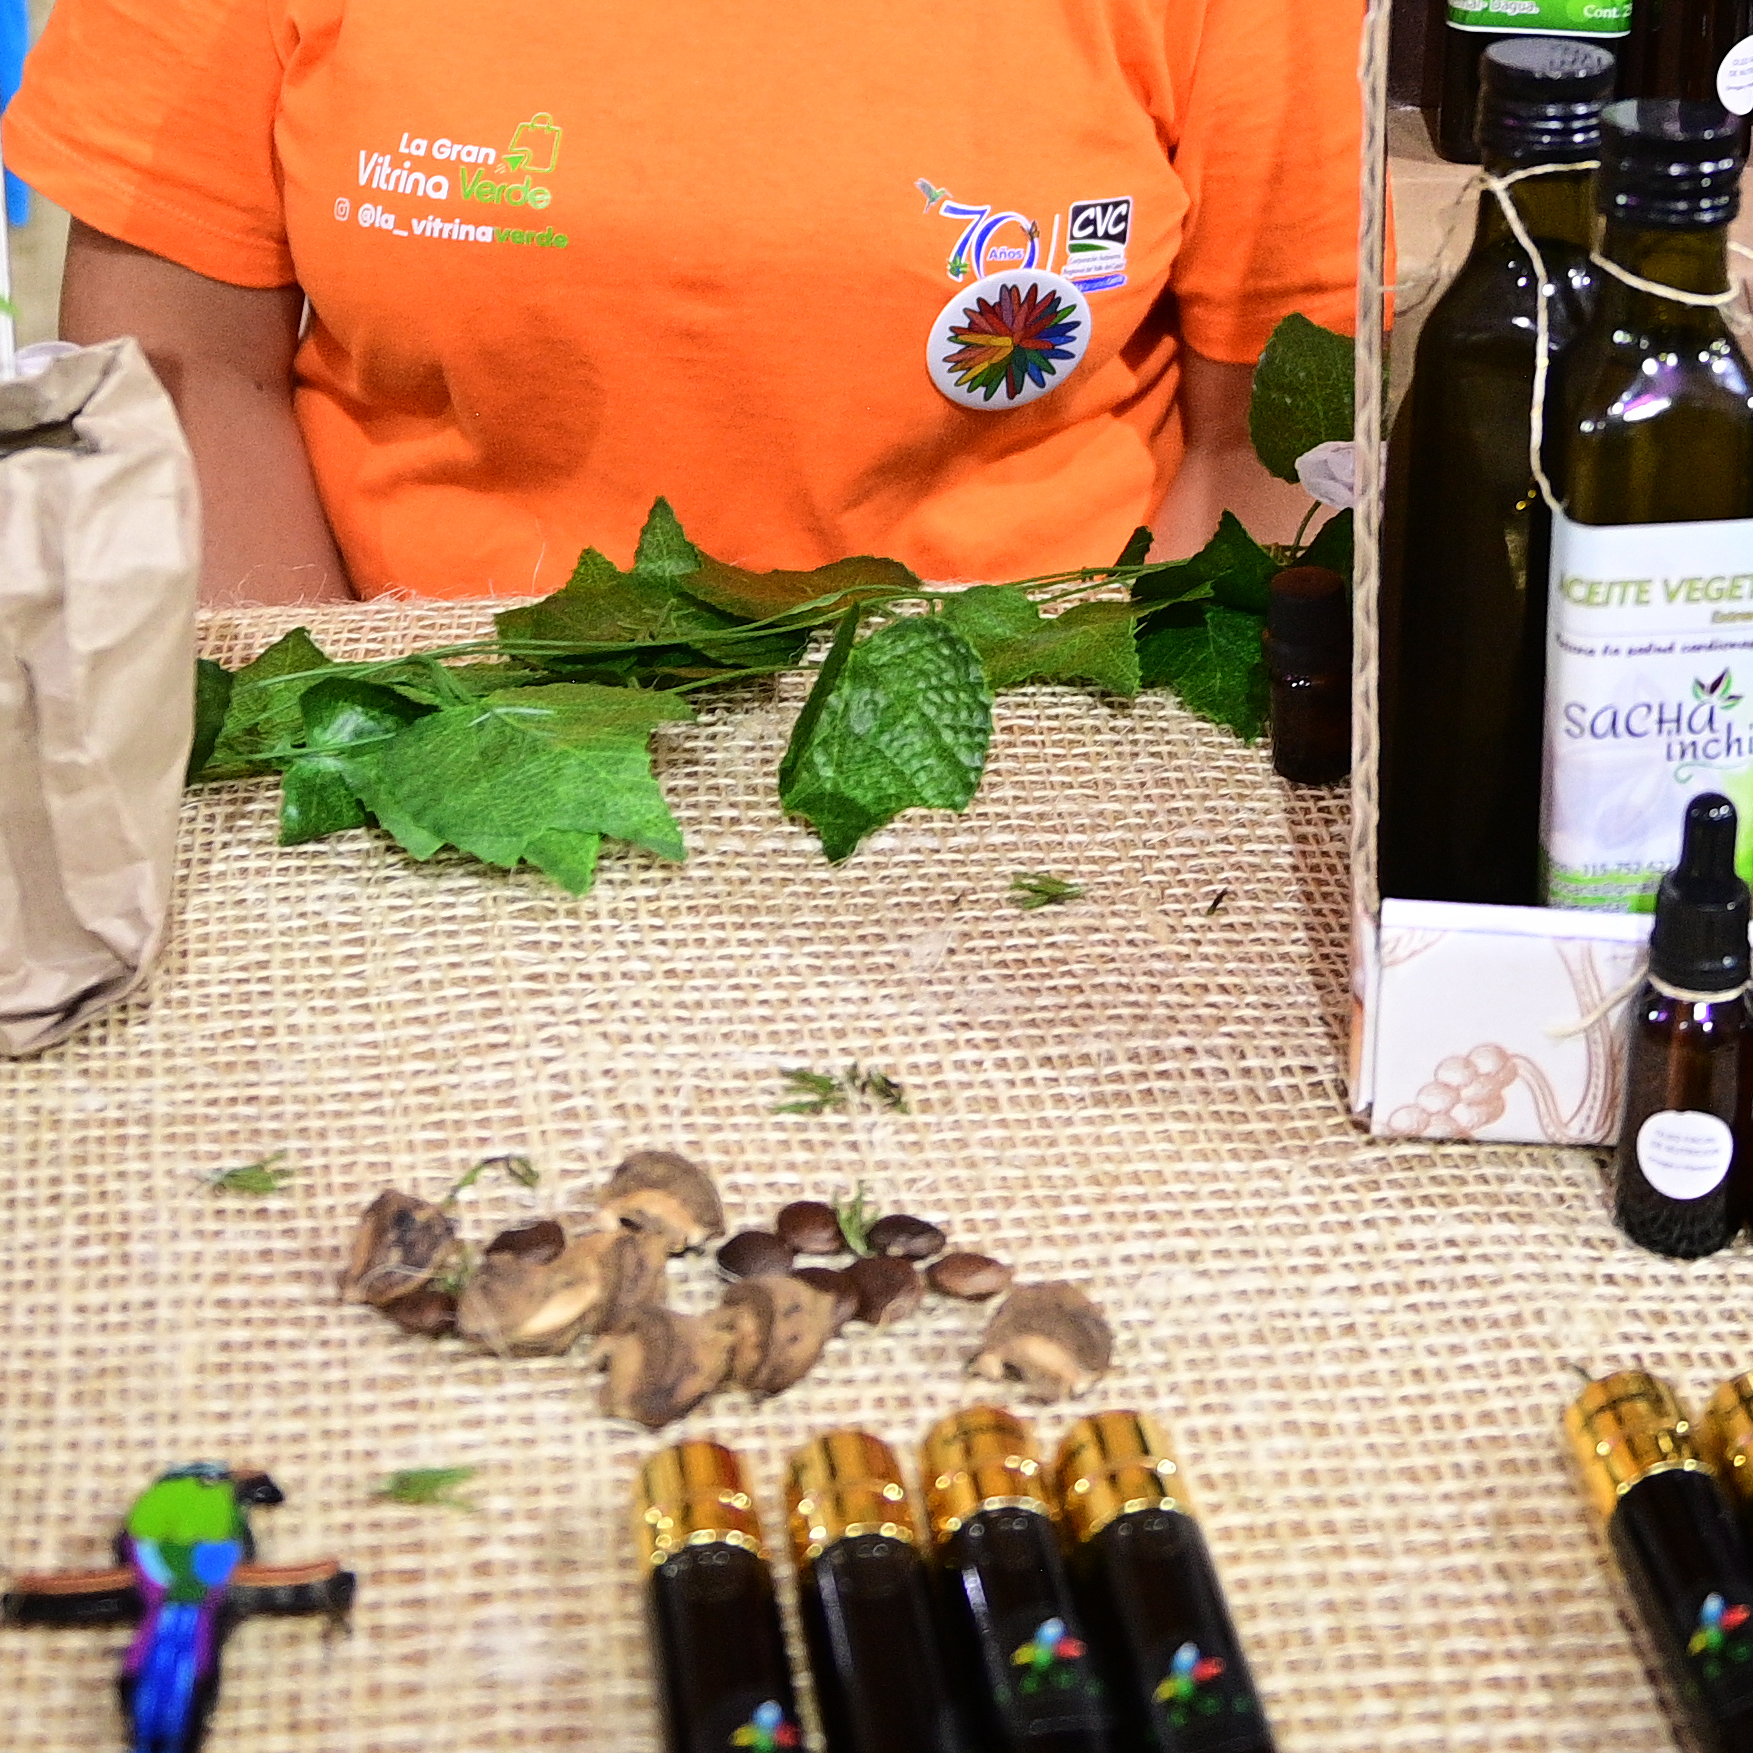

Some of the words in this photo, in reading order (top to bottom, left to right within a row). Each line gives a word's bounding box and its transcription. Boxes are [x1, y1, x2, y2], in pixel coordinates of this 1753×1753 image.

[398, 132, 428, 157] La
[432, 138, 496, 165] Gran
[358, 150, 449, 200] Vitrina
[459, 166, 551, 209] Verde
[358, 203, 568, 248] @la_vitrinaverde
[1072, 203, 1128, 238] CVC
[987, 247, 1025, 261] Años
